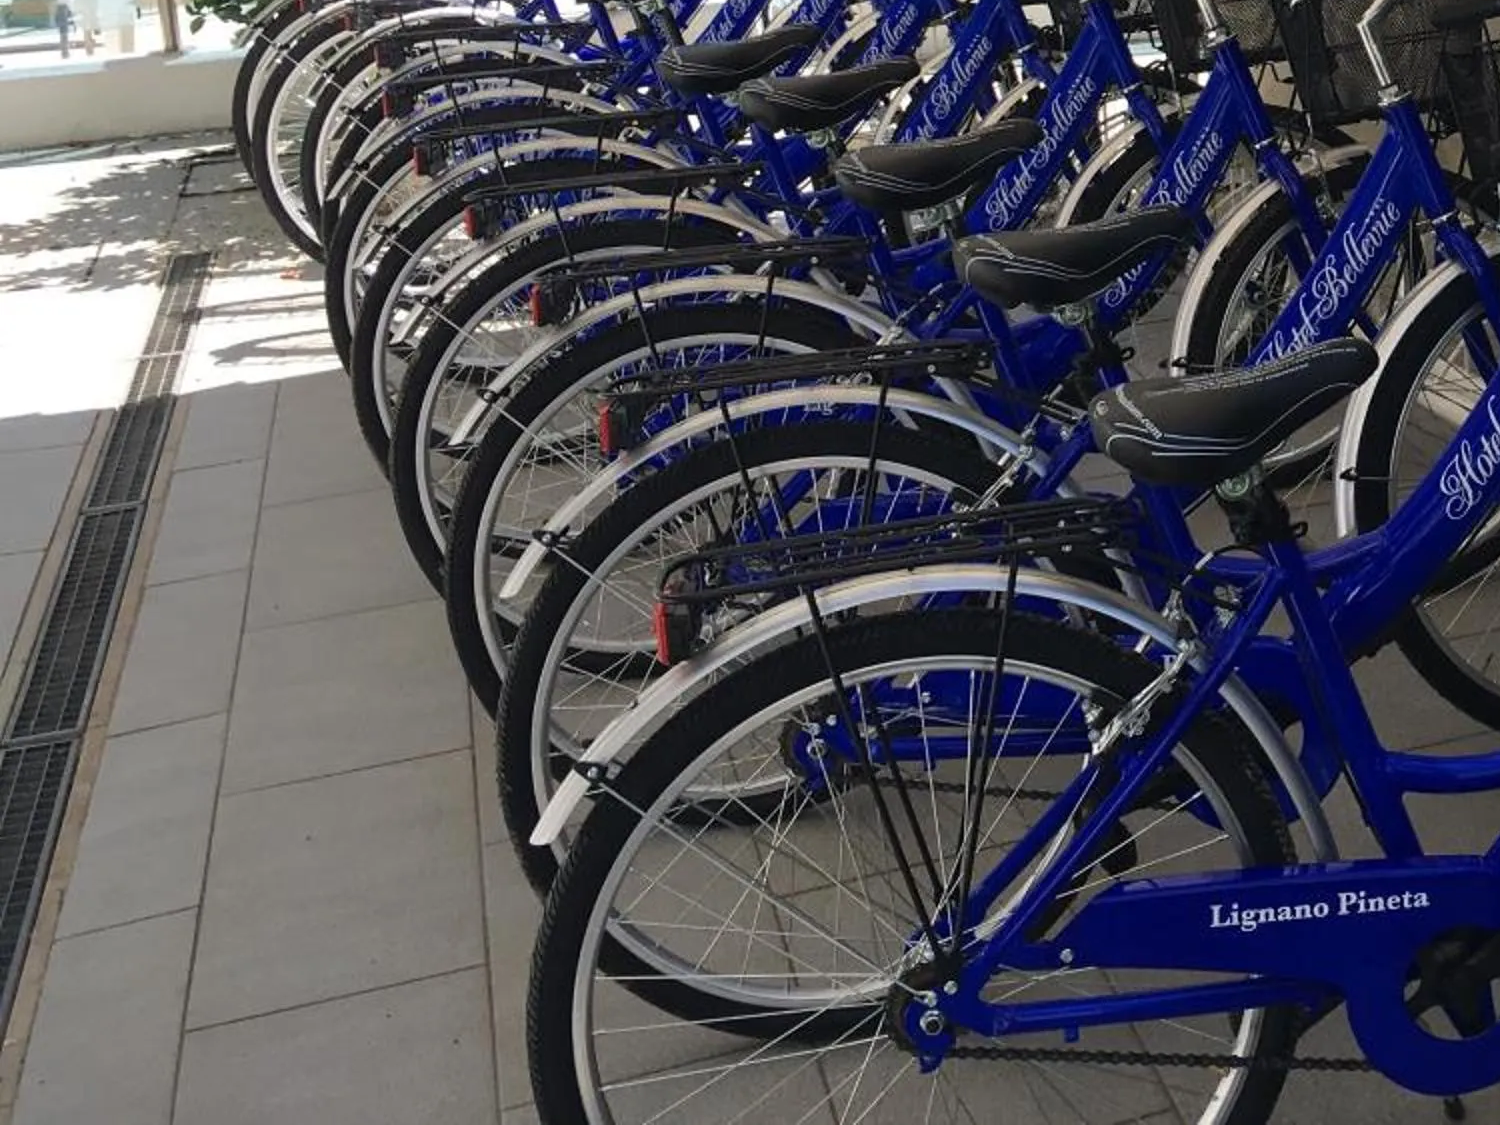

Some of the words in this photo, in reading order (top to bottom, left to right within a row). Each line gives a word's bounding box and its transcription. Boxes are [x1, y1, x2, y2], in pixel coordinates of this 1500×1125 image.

[1312, 202, 1401, 320] Bellevue
[1209, 903, 1329, 931] Lignano
[1337, 890, 1430, 916] Pineta
